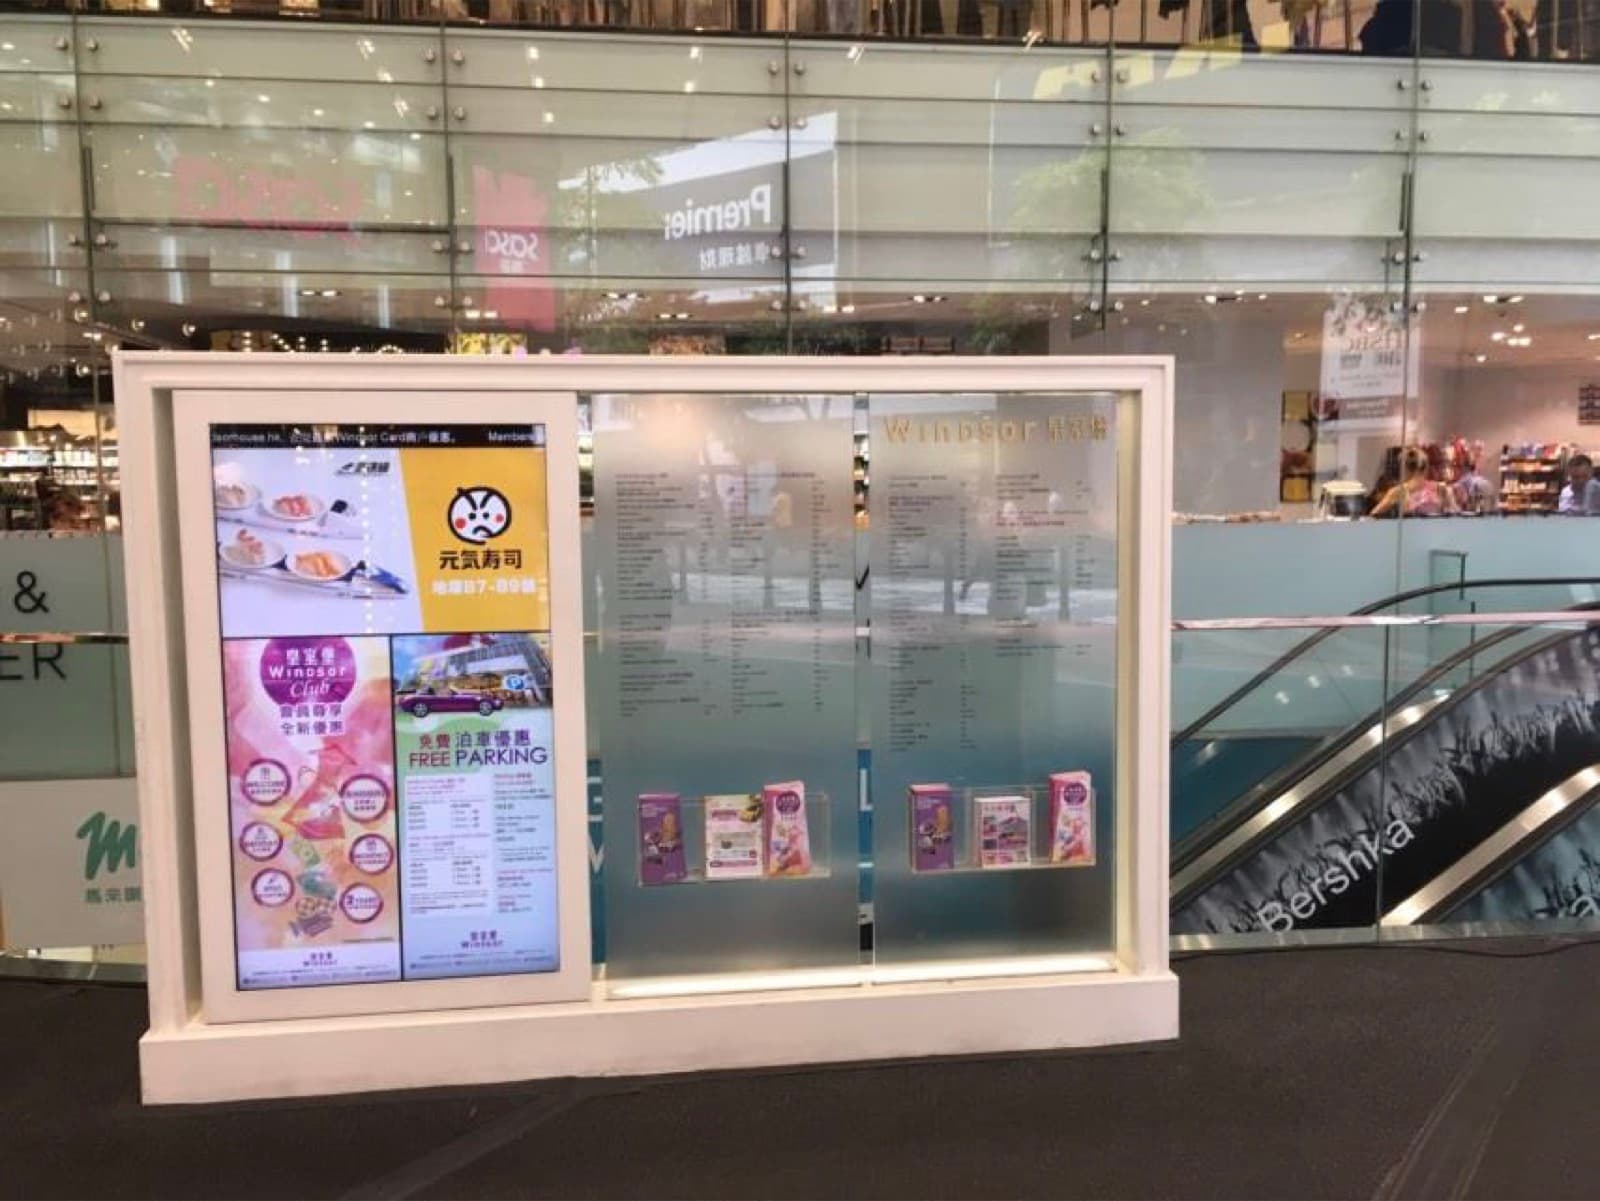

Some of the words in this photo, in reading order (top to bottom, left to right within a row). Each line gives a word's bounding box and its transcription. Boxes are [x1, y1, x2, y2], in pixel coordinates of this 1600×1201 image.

[409, 752, 450, 768] FREE
[456, 747, 548, 766] PARKING
[1257, 819, 1414, 934] Bershka
